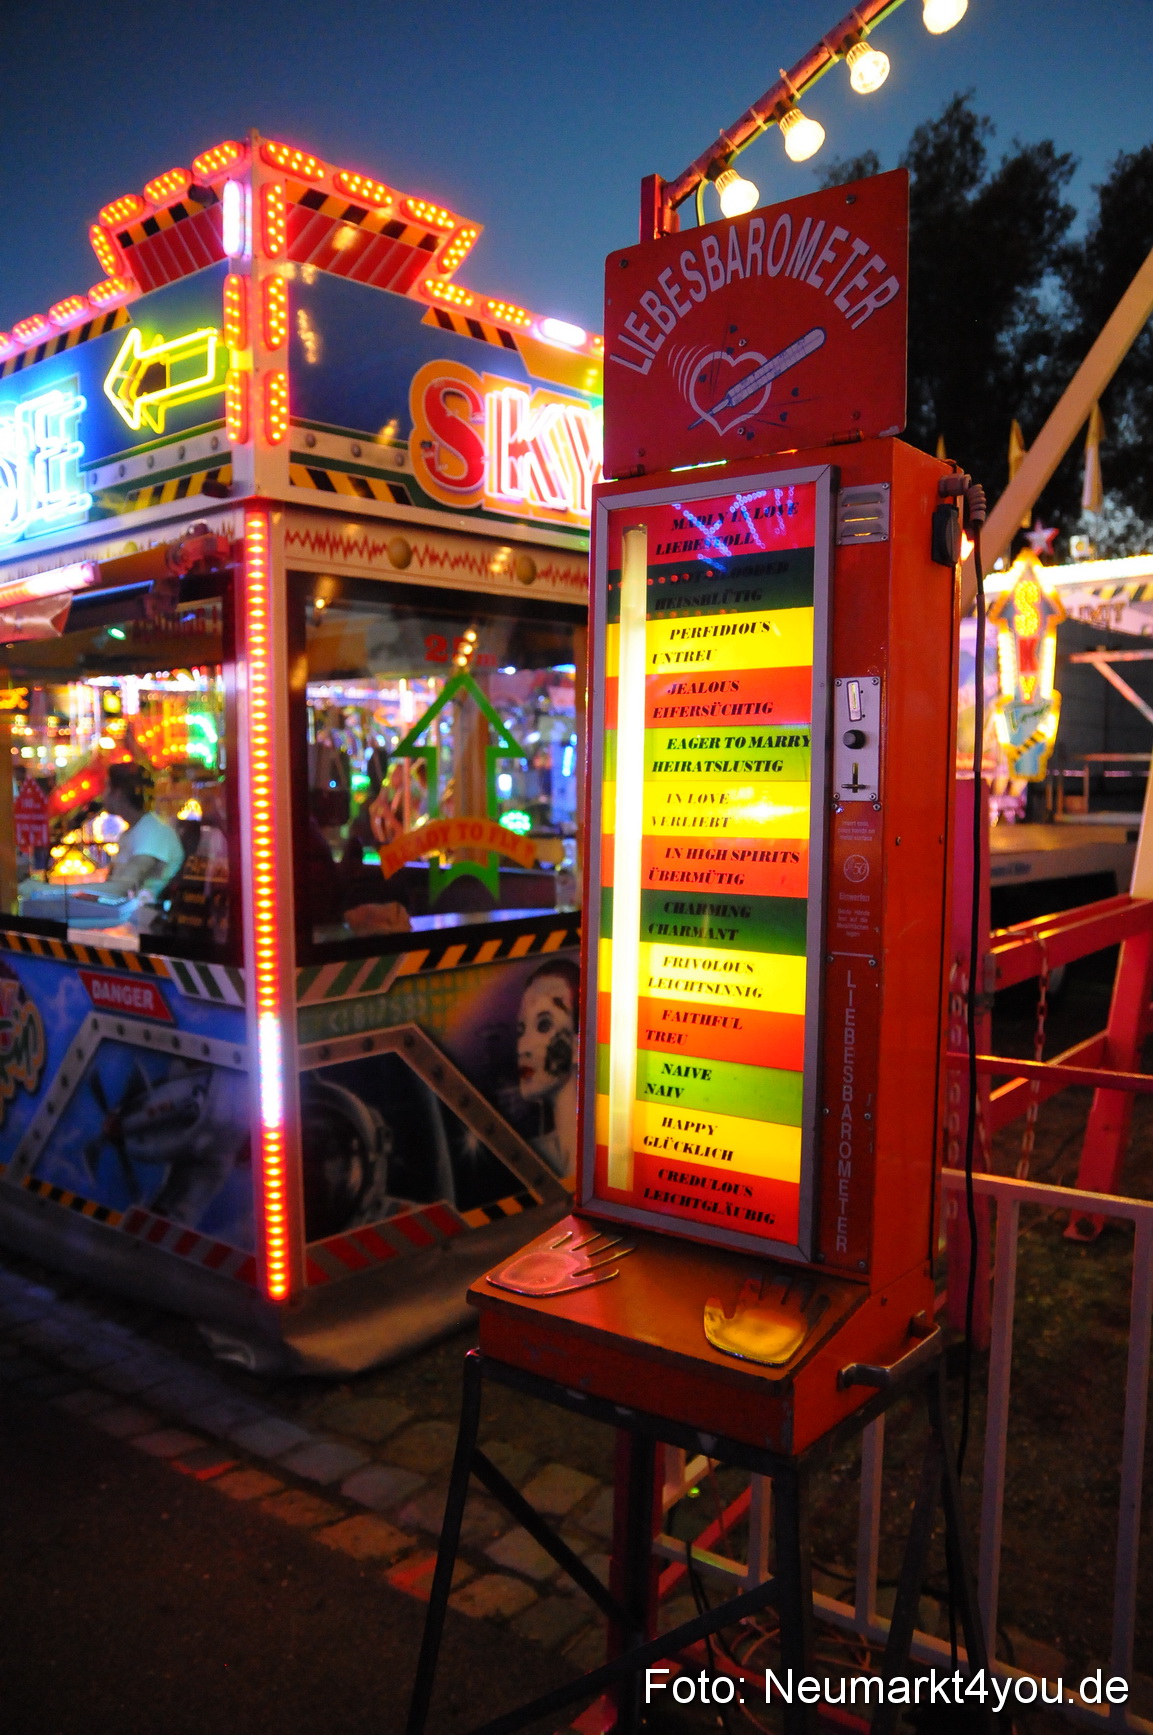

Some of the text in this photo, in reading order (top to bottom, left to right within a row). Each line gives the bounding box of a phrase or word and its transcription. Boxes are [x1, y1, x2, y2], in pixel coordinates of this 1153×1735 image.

[609, 213, 900, 375] LIEBESBAROMETER
[671, 509, 729, 531] MADLY
[754, 502, 799, 520] LOVE
[655, 532, 754, 555] LIEBESTOLL
[655, 588, 762, 611] HEISSBLÜTIG
[670, 620, 770, 640] PERFIDIOUS
[652, 649, 717, 664] UNTREU
[667, 680, 739, 695] JEALOUS
[653, 701, 773, 718] EIFERSÜCHTIG
[666, 735, 812, 750] EAGER TO MARRY
[652, 760, 783, 773] HEIRATSLUSTIG
[667, 793, 730, 805] IN LOVE
[651, 816, 732, 828] VERLIEBT
[457, 823, 484, 841] TO
[664, 848, 800, 864] IN HIGH SPIRITS
[648, 867, 745, 885] ÜBERMÜTIG
[663, 901, 752, 919] CHARMING
[648, 923, 739, 941] CHARMANT
[663, 956, 755, 974] FRIVOLOUS
[92, 979, 154, 1010] DANGER
[648, 977, 764, 999] LEICHTSINNIG
[661, 1009, 743, 1030] FAITHFUL
[646, 1029, 688, 1046] TREU
[661, 1063, 712, 1081] NAIVE
[644, 1082, 685, 1100] NAIV
[661, 1117, 718, 1136] HAPPY
[643, 1135, 734, 1162] GLÜCKLICH
[658, 1168, 754, 1198] CREDULOUS
[643, 1187, 776, 1225] LEICHTGLÄUBIG
